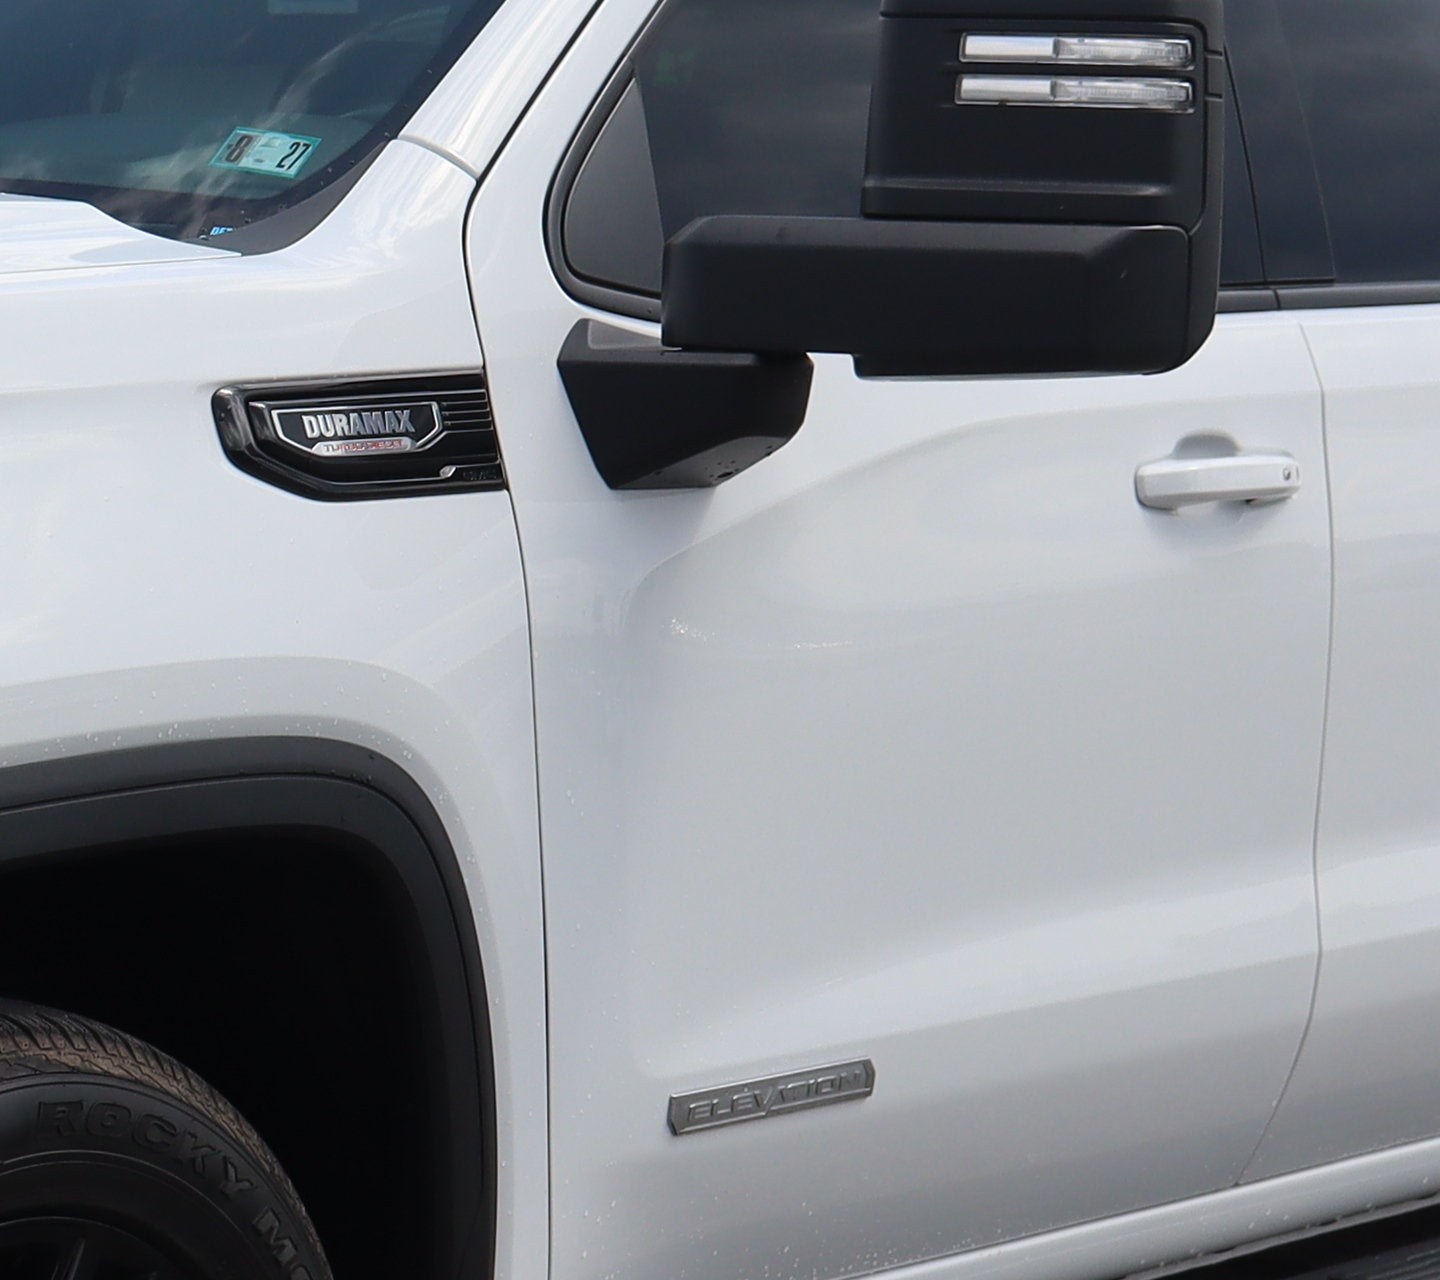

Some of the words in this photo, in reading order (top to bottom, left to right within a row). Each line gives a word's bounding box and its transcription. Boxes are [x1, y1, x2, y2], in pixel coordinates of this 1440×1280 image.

[275, 141, 312, 171] 27
[301, 410, 416, 439] DURAMAX
[687, 1069, 862, 1121] ELEVATION
[36, 1099, 257, 1198] ROCKY
